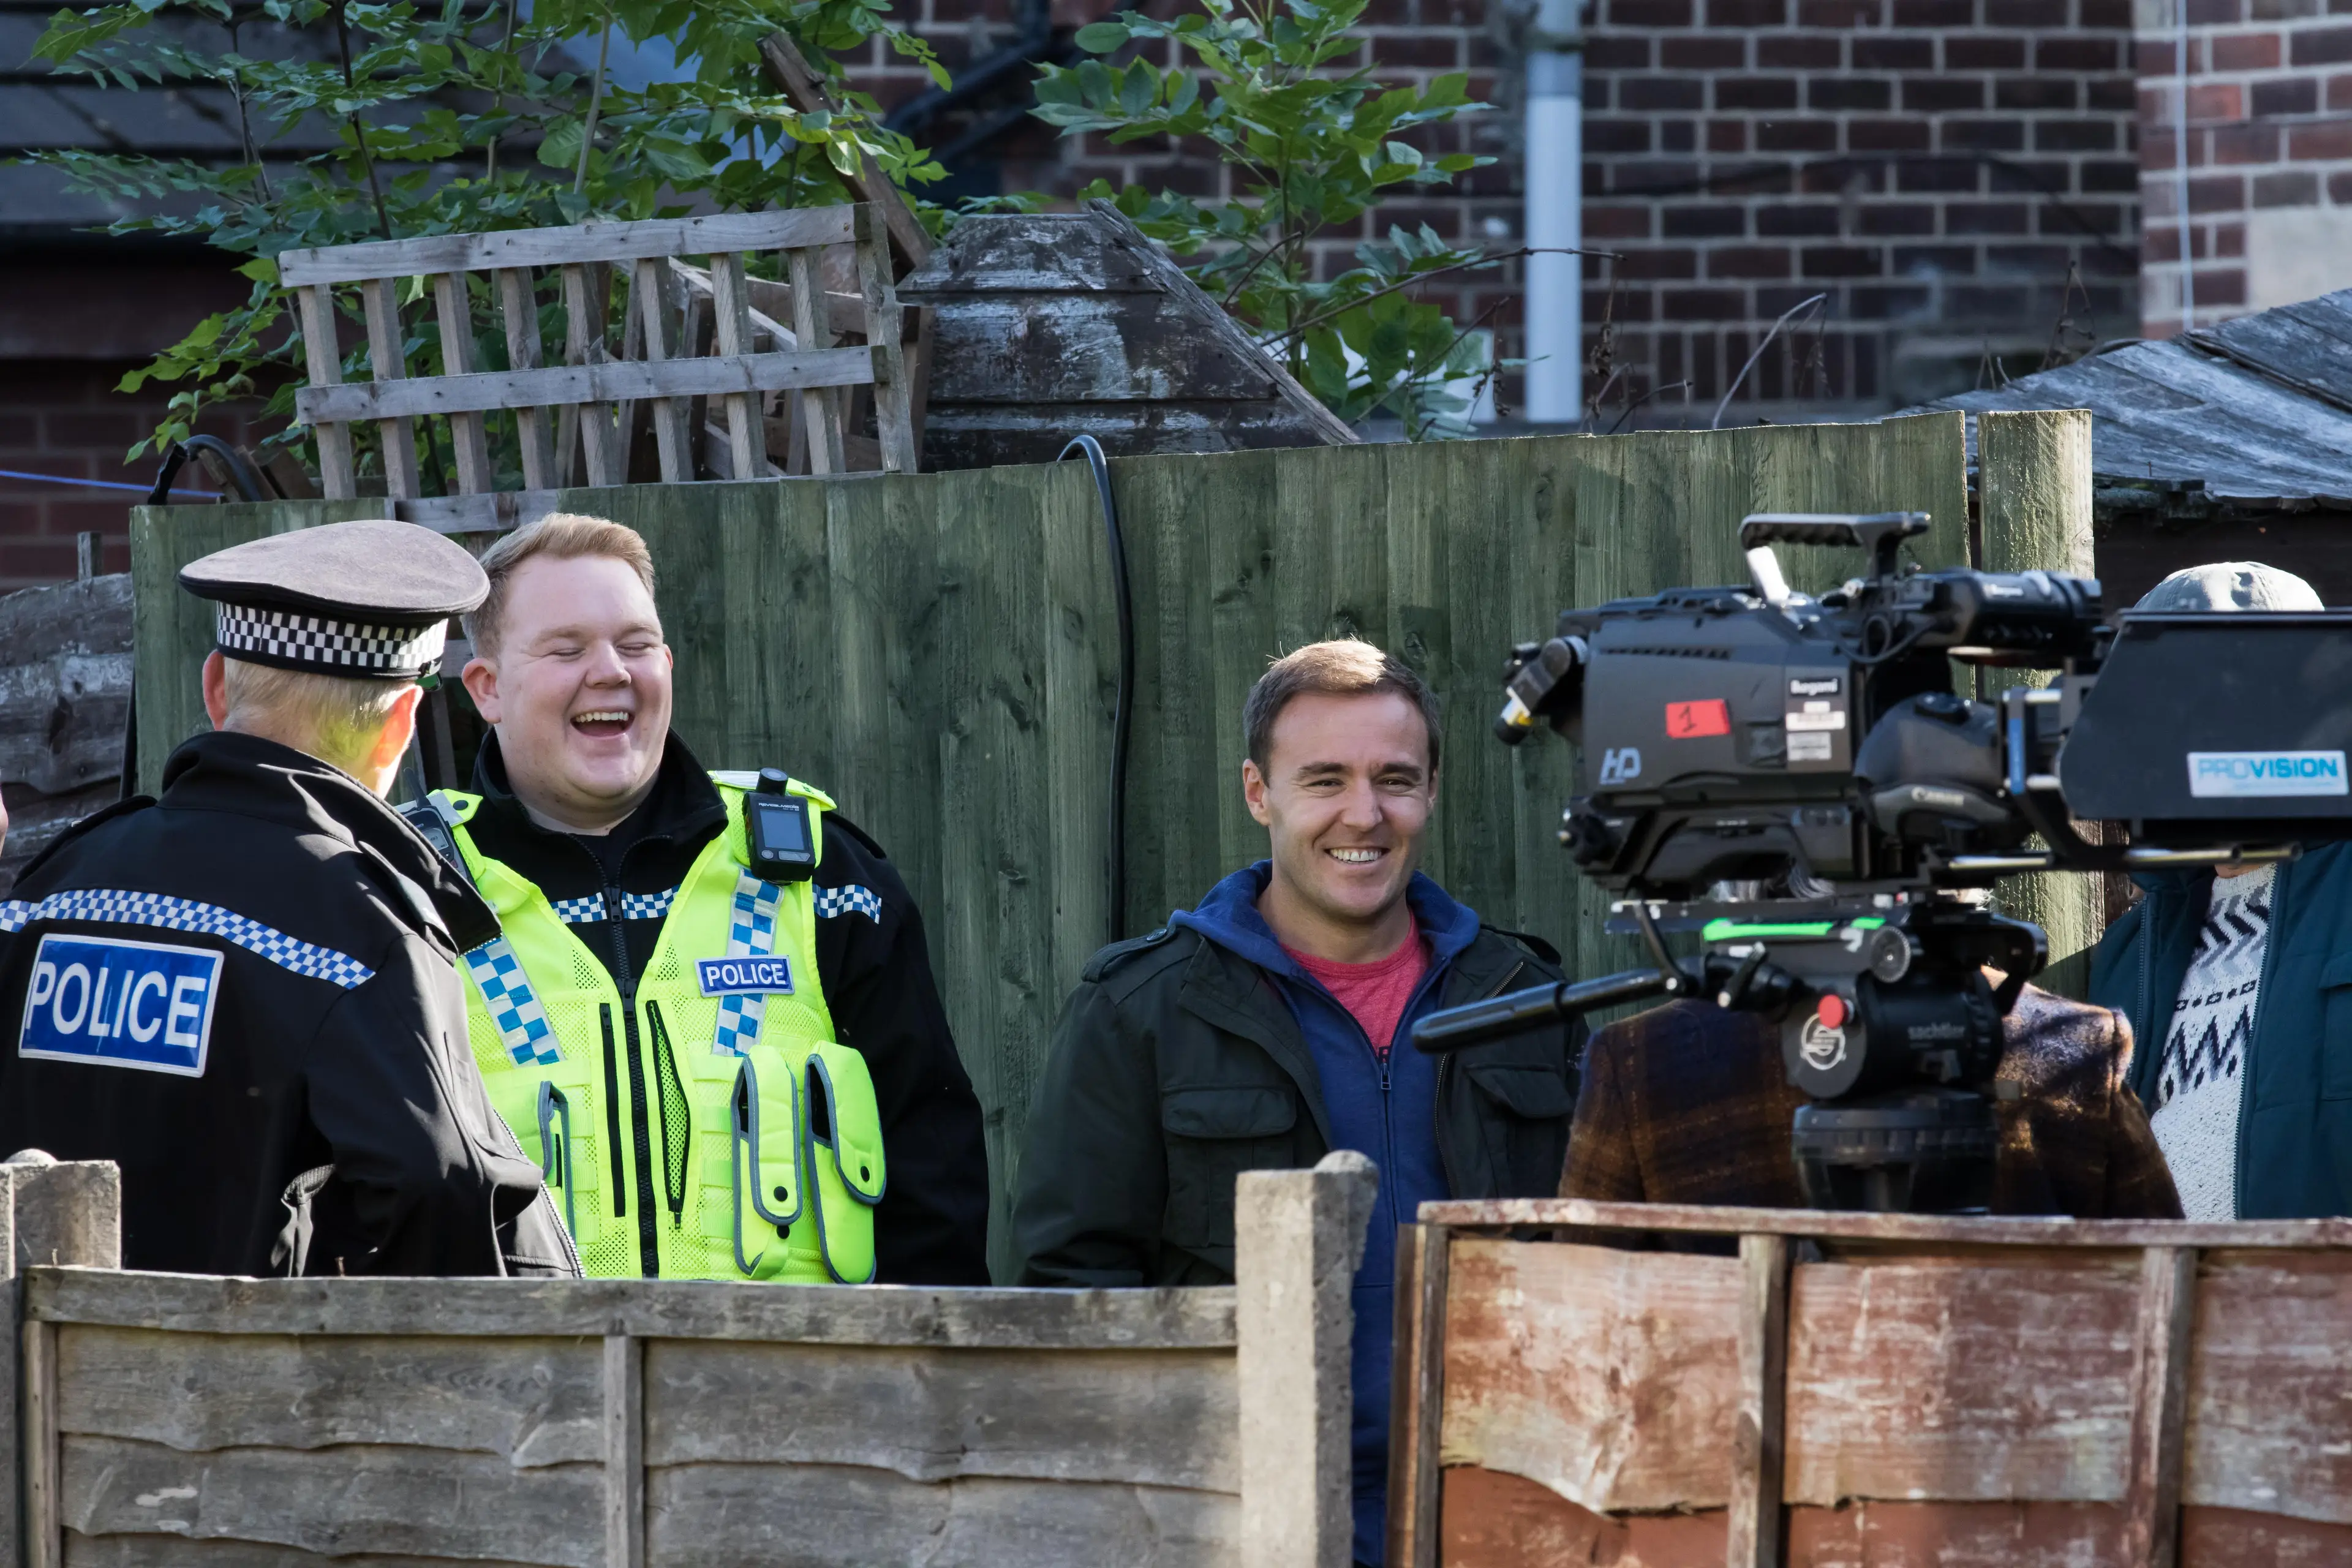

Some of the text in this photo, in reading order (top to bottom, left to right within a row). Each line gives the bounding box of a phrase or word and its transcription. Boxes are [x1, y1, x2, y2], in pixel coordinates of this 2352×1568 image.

[1679, 705, 1698, 733] 1
[1600, 747, 1642, 785] HD
[706, 963, 786, 987] POLICE
[25, 961, 207, 1048] POLICE
